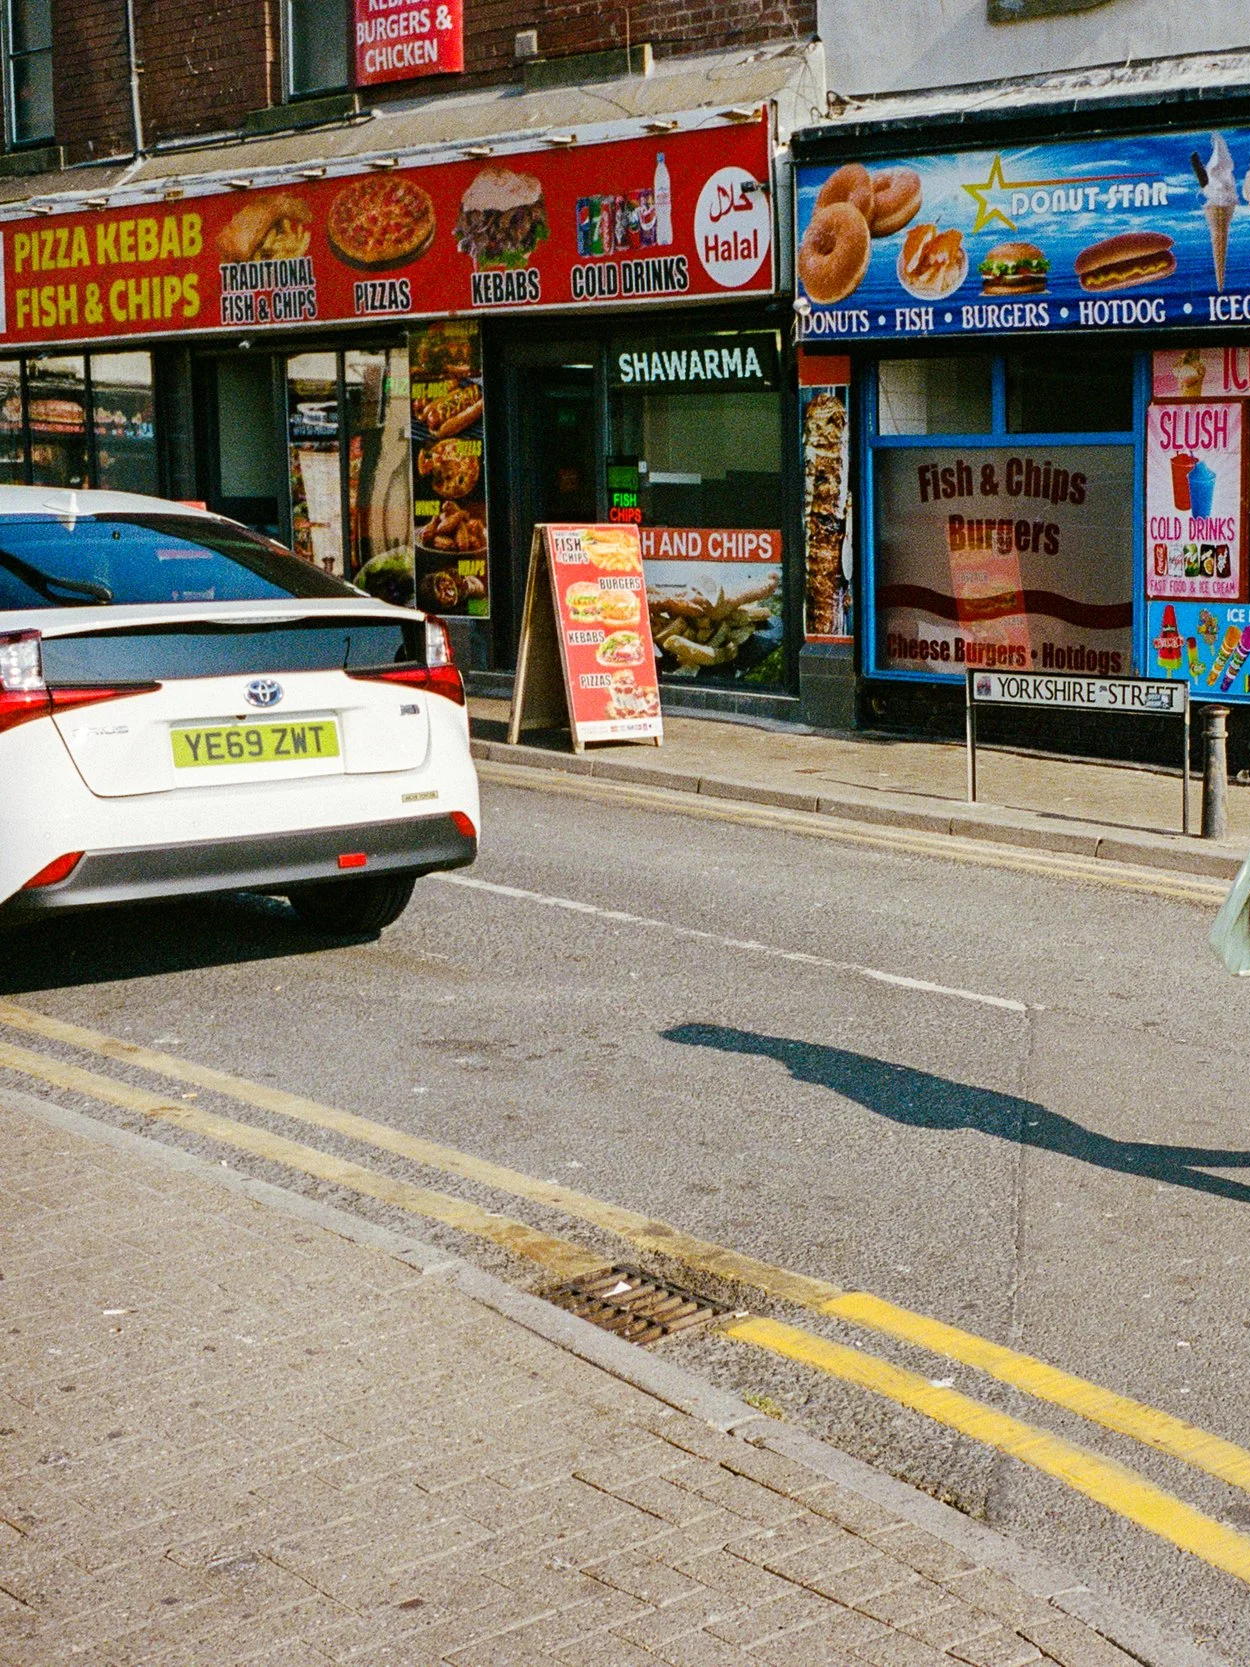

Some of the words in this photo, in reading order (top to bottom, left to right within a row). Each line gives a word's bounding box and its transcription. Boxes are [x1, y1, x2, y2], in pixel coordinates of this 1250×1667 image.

[357, 9, 431, 45] BURGERS
[435, 5, 453, 30] &
[365, 38, 438, 73] CHICKEN
[1011, 186, 1105, 216] DONUT
[1107, 182, 1169, 210] STAR
[14, 228, 90, 274] PIZZA
[97, 212, 203, 265] KEBAB
[704, 229, 759, 263] Halal
[221, 258, 315, 291] TRADITIONAL
[472, 269, 540, 304] KEBABS
[572, 264, 617, 298] COLD
[622, 256, 688, 295] DRINKS
[16, 284, 78, 329] FISH
[85, 282, 103, 324] &
[109, 273, 199, 322] CHIPS
[222, 295, 254, 325] FISH
[259, 296, 269, 320] &
[273, 291, 316, 319] CHIPS
[355, 280, 411, 313] PIZZAS
[801, 309, 869, 334] DONUTS
[895, 307, 934, 331] FISH
[962, 303, 1050, 329] BURGERS
[1079, 298, 1166, 325] HOTDOG
[618, 347, 763, 383] SHAWARMA
[1160, 409, 1228, 450] SLUSH
[917, 459, 974, 503] Fish
[980, 463, 999, 496] &
[1005, 457, 1088, 505] Chips
[609, 508, 642, 523] CHIPS
[613, 493, 637, 507] FISH
[555, 538, 581, 552] FISH
[659, 531, 702, 557] AND
[708, 533, 773, 559] CHIPS
[949, 514, 1061, 556] Burgers
[1150, 516, 1182, 541] COLD
[1189, 517, 1236, 542] DRINKS
[562, 552, 589, 563] CHIPS
[600, 578, 641, 590] BURGERS
[1150, 580, 1166, 593] FAST
[1227, 609, 1245, 623] ICE
[568, 631, 605, 644] KEBABS
[887, 633, 950, 662] Cheese
[954, 637, 1027, 668] Burgers
[1042, 642, 1122, 675] Hotdogs
[581, 675, 612, 687] PIZZAS
[997, 677, 1096, 703] YORKSHIRE
[185, 728, 262, 761] YE69
[274, 726, 325, 756] ZWT
